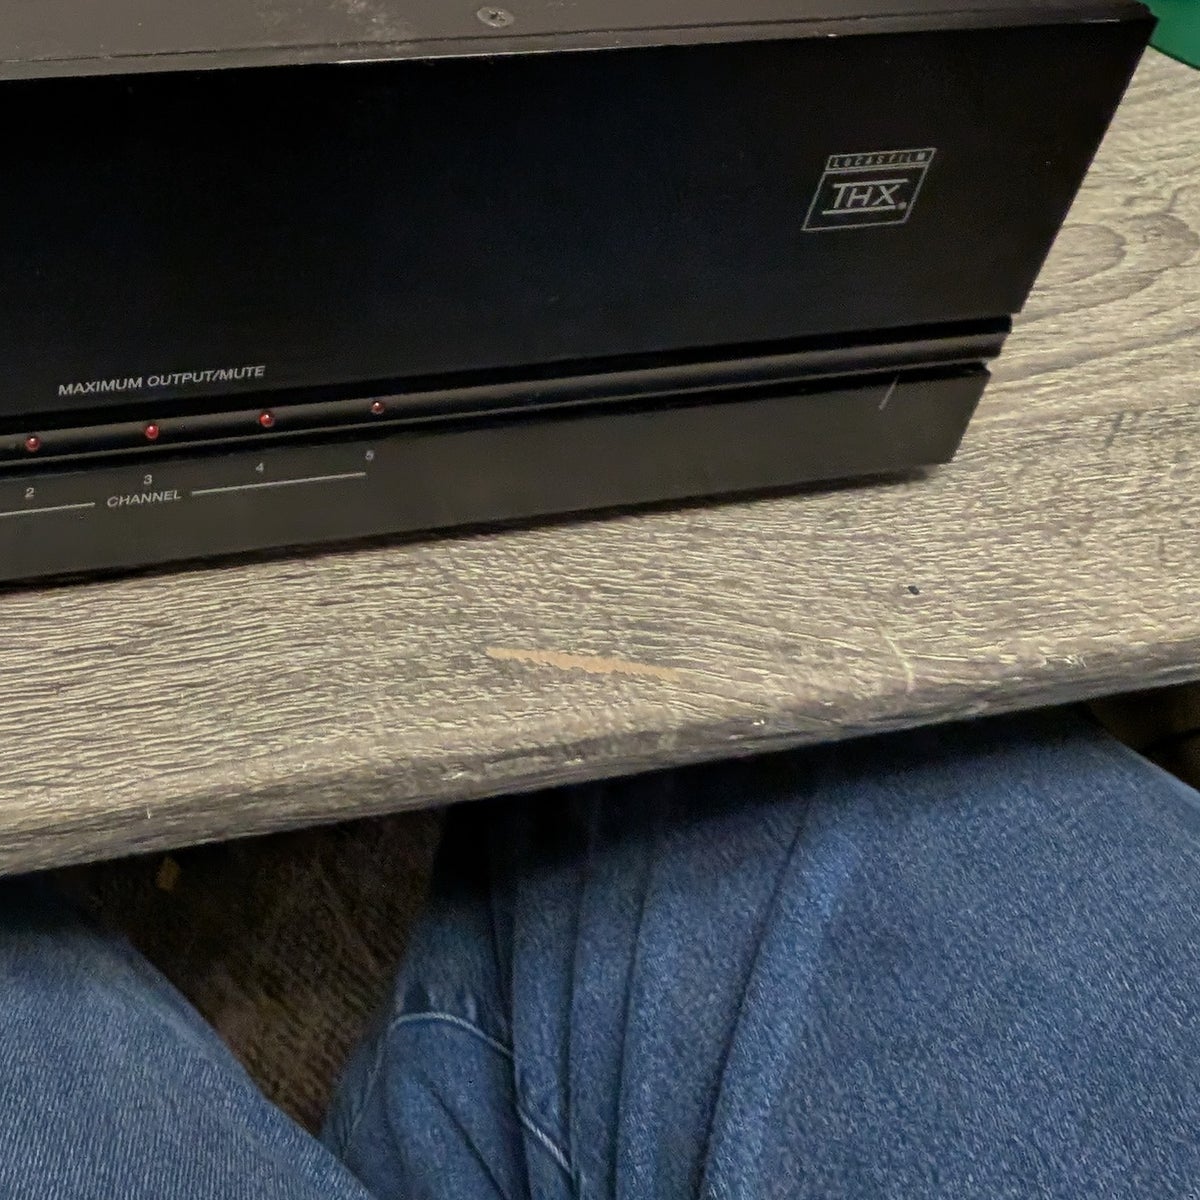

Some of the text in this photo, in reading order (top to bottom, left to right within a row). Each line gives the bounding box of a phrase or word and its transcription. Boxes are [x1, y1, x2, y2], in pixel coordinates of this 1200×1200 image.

[832, 178, 906, 210] THX
[57, 365, 267, 396] MAXIMUM OUTPUT/MUTE
[24, 486, 36, 500] 2
[142, 474, 154, 487] 3
[255, 462, 266, 474] 4
[105, 489, 183, 508] CHANNEL
